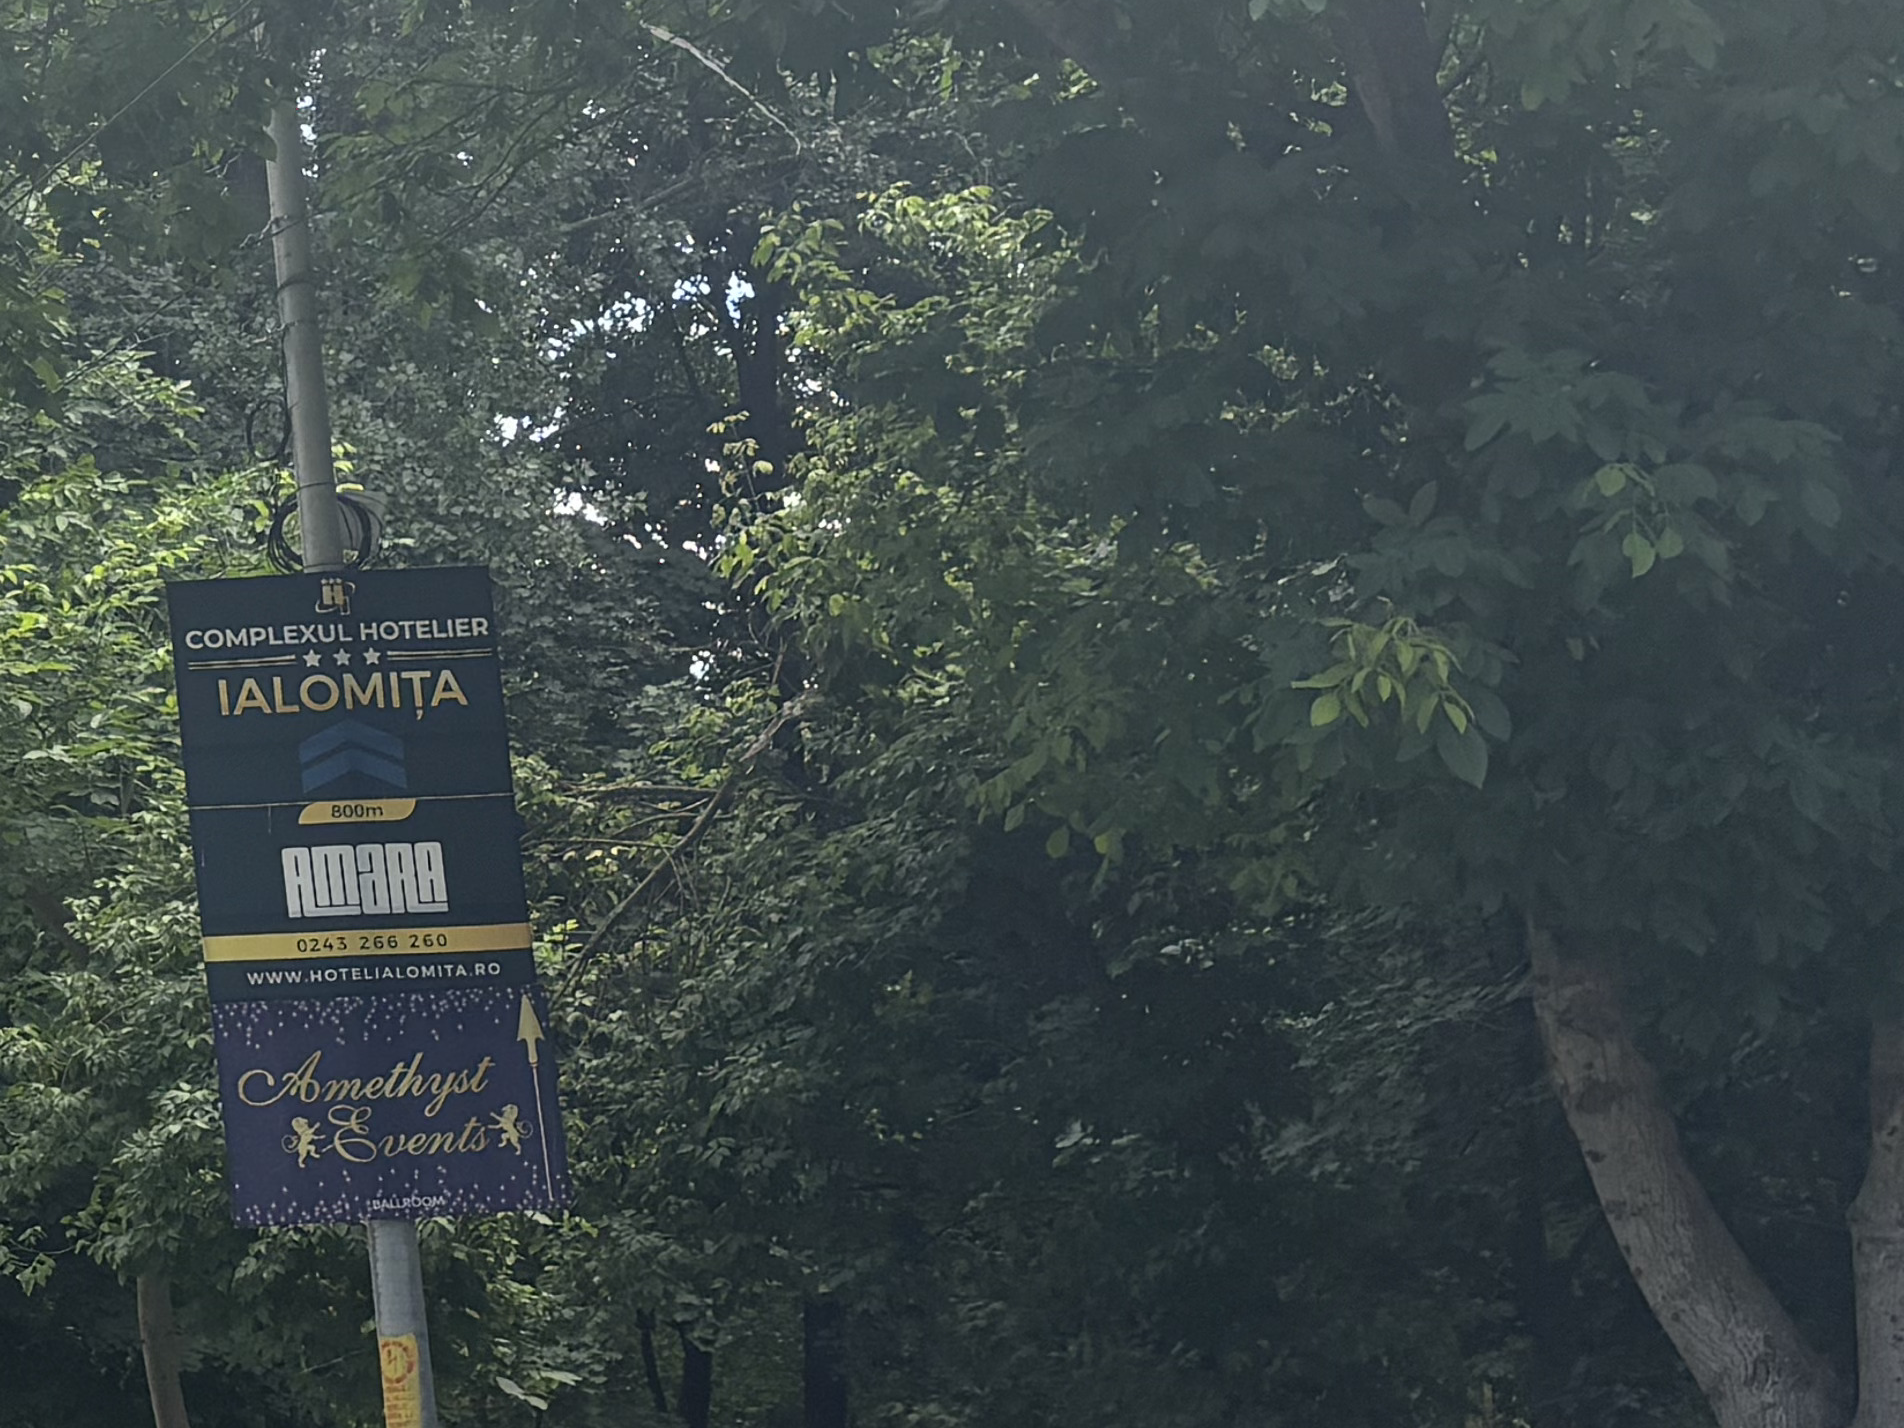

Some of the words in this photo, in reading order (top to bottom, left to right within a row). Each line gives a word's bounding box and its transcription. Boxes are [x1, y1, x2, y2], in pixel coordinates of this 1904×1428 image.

[185, 622, 353, 650] COMPLEXUL
[360, 617, 490, 641] HOTELIER
[217, 669, 469, 721] IALOMIȚA
[331, 803, 384, 818] 800m
[296, 936, 348, 953] 0243
[359, 934, 399, 951] 266
[409, 932, 448, 949] 260
[246, 962, 502, 985] WWW.HOTELIALOMITA.RO
[237, 1050, 496, 1118] Amethyst
[321, 1104, 490, 1163] Events
[372, 1195, 446, 1210] BALLROOM
